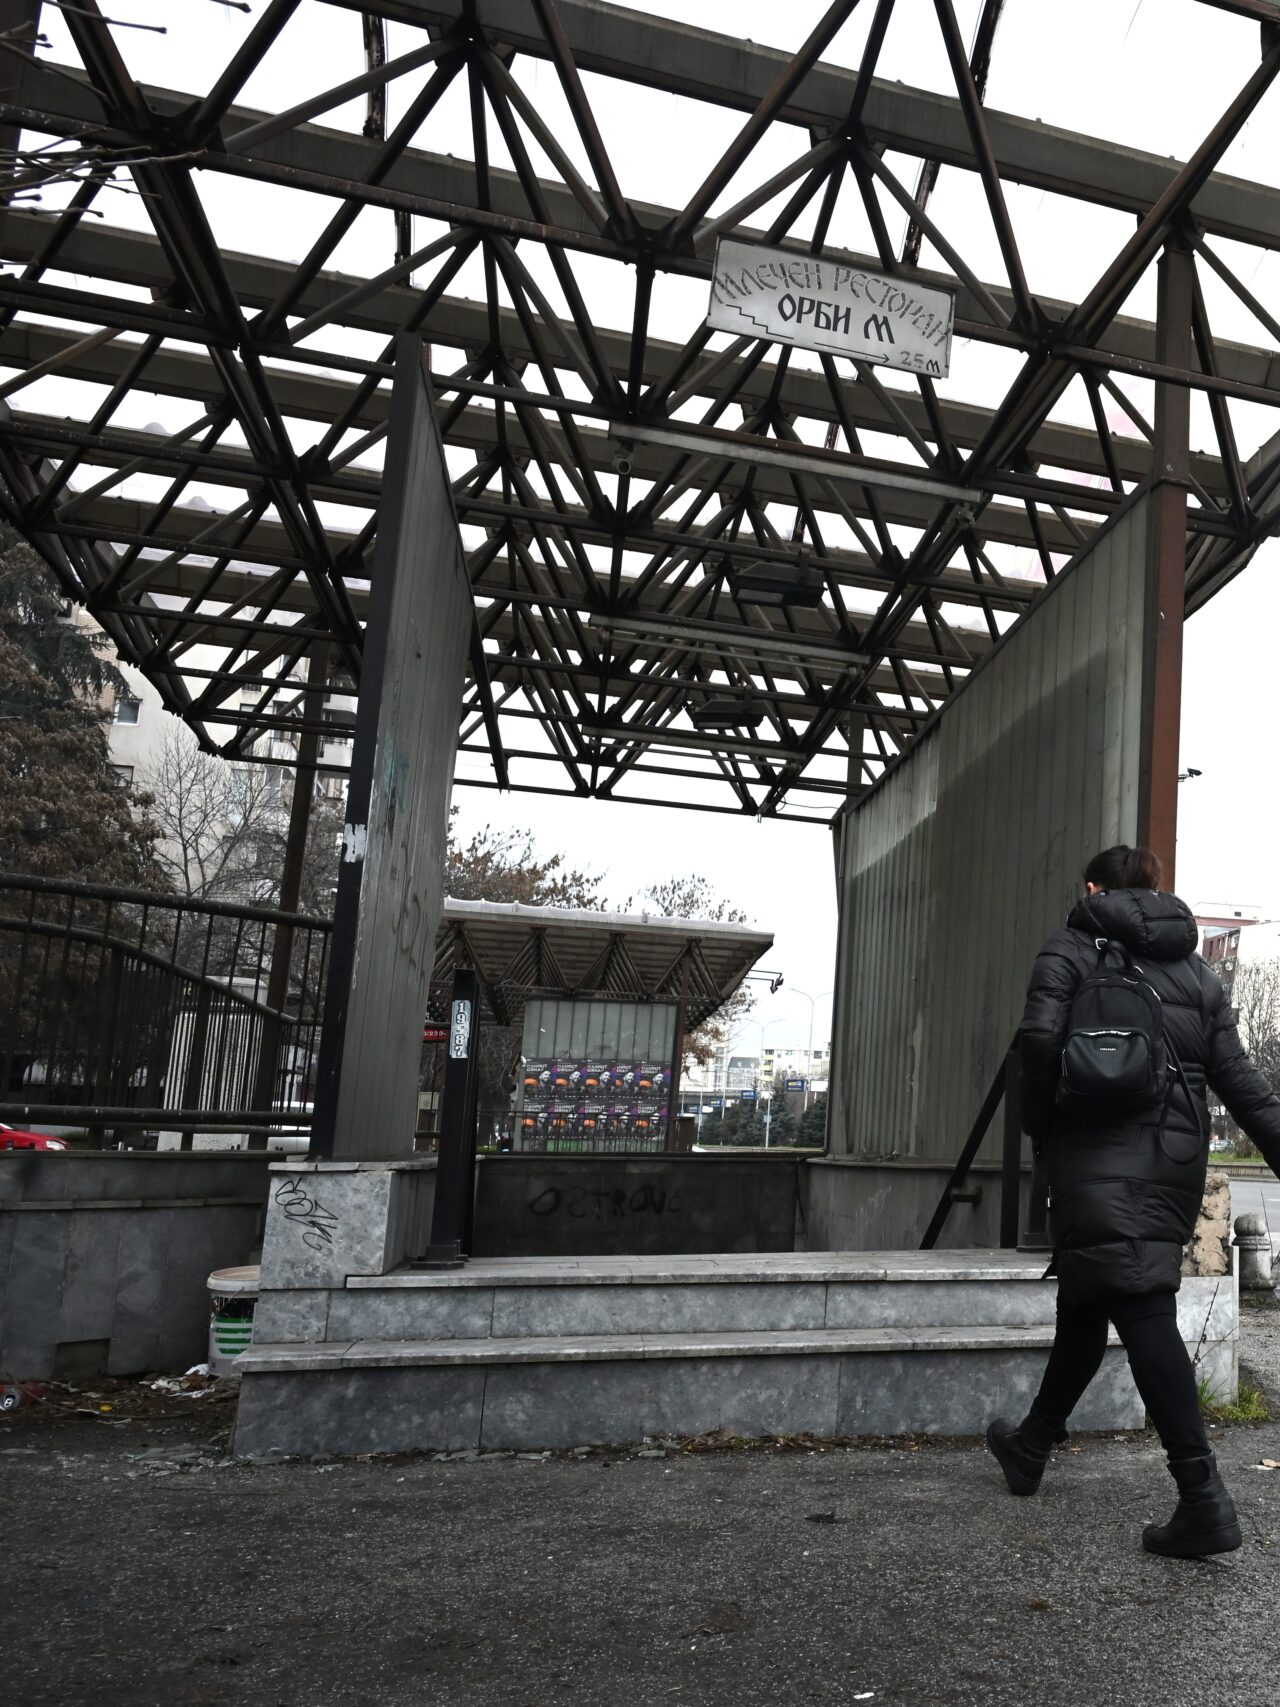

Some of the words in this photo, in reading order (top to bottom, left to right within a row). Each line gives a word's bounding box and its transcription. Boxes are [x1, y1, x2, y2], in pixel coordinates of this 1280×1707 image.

[777, 292, 852, 335] ОРБИ
[863, 312, 895, 344] М
[833, 266, 949, 347] РЕСТОРАН
